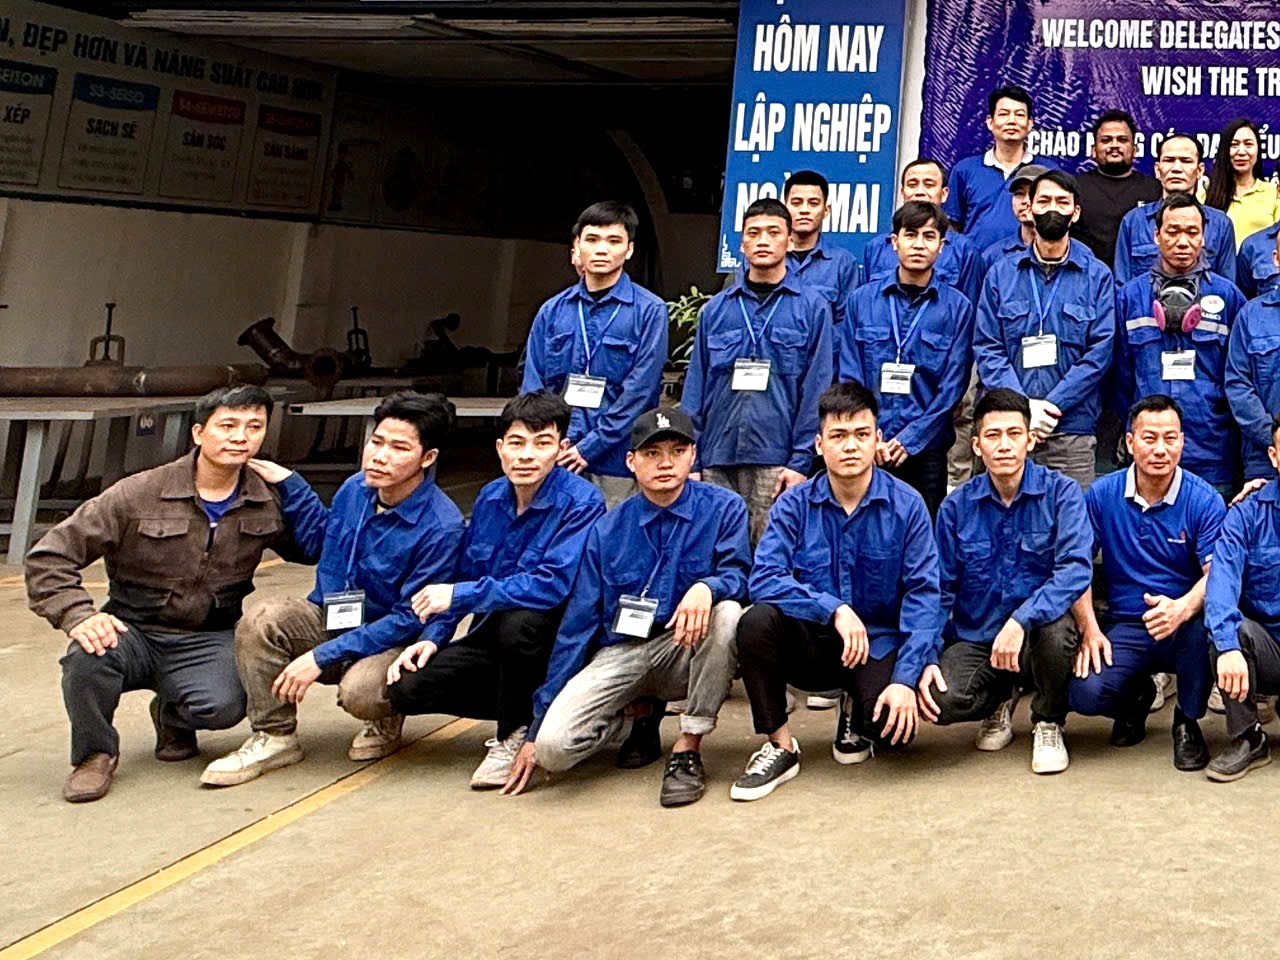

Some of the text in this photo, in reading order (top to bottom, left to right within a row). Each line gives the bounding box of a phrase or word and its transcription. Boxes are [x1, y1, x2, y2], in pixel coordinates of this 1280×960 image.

[23, 22, 68, 55] ĐẸP
[753, 14, 885, 73] HÔM NAY
[1042, 18, 1153, 49] WELCOME
[1140, 65, 1202, 96] WISH
[1207, 66, 1249, 97] THE
[734, 92, 892, 163] LẬP NGHIỆP
[1028, 127, 1080, 156] CHÀO
[821, 183, 880, 233] MAI
